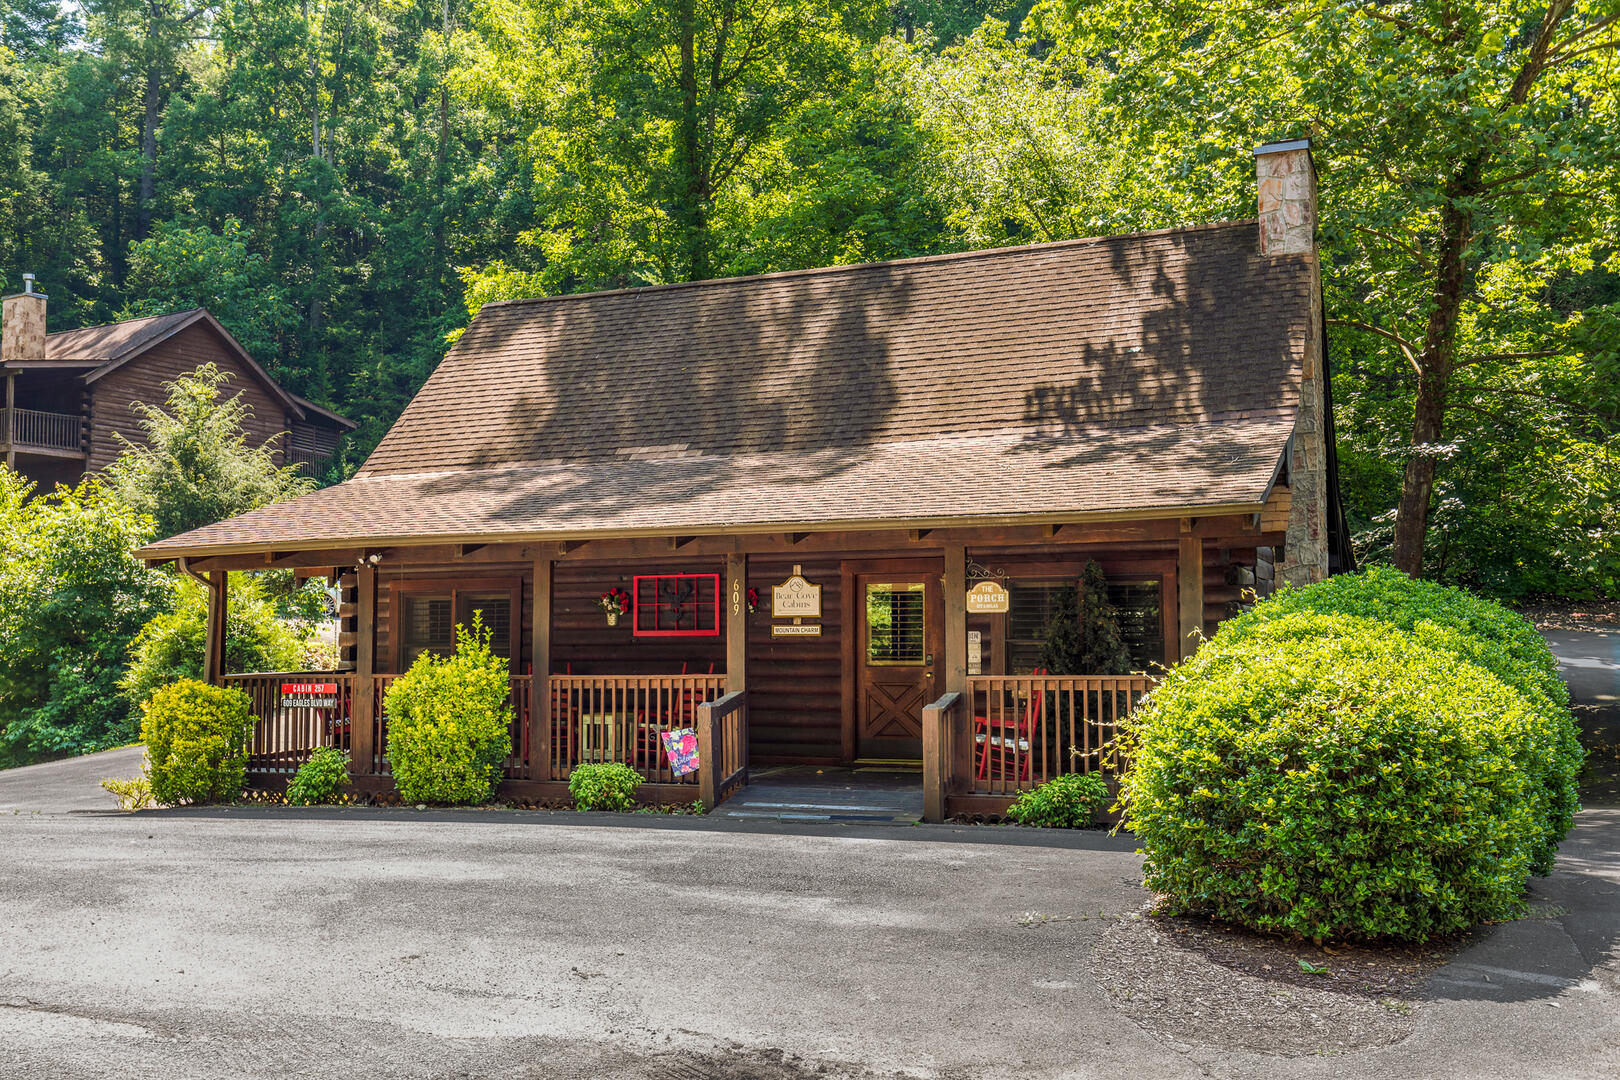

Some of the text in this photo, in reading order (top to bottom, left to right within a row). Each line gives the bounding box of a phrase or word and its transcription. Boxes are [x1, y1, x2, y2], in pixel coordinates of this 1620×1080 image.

[776, 592, 817, 600] Bear Cove
[970, 594, 1005, 602] PORCH
[783, 600, 811, 608] Cabins
[315, 684, 325, 692] 257
[293, 699, 310, 707] EAGLES
